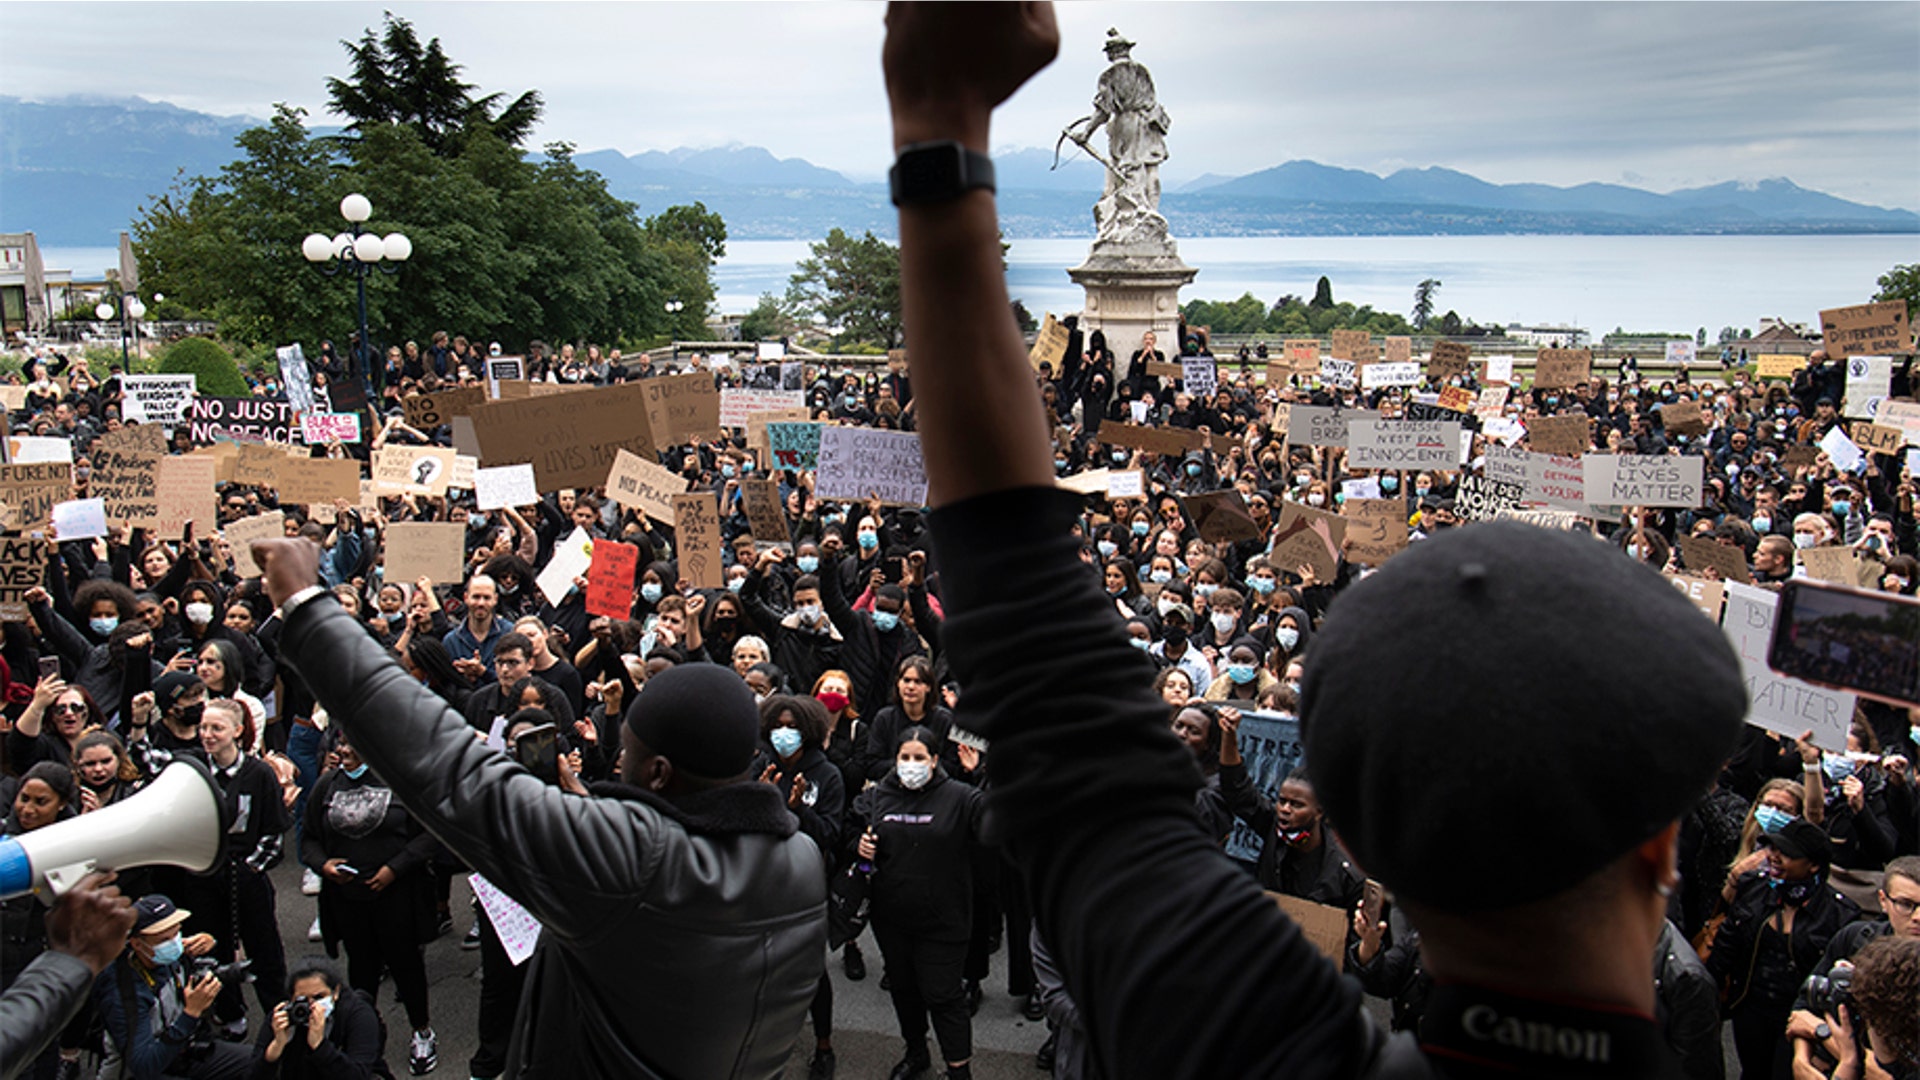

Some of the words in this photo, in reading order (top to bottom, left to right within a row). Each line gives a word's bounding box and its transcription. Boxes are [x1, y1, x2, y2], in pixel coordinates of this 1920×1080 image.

[649, 379, 714, 402] JUSTICE
[192, 400, 224, 420] NO
[230, 401, 328, 422] JUSTE
[407, 398, 434, 412] NO
[411, 412, 440, 425] NO
[1310, 427, 1350, 441] BREA
[1373, 423, 1390, 432] LA
[1395, 422, 1443, 433] SUISSE
[824, 433, 840, 446] LA
[853, 436, 922, 453] COULEUR
[1417, 434, 1443, 445] PAS
[1856, 425, 1897, 451] BLM
[1357, 447, 1456, 463] INNOCENTE
[1618, 455, 1677, 467] BLACK
[820, 464, 846, 480] PAS
[1486, 460, 1526, 475] SILENCE
[1617, 468, 1679, 482] LIVES
[618, 475, 637, 493] NO
[637, 482, 673, 507] PEAC
[1612, 483, 1695, 501] MATTER
[678, 500, 703, 512] PAS
[160, 520, 201, 533] NAE
[685, 525, 706, 534] PAS
[0, 540, 44, 565] ACK
[684, 541, 710, 551] PAIX
[0, 566, 41, 585] VES
[1462, 1004, 1611, 1063] Canon
